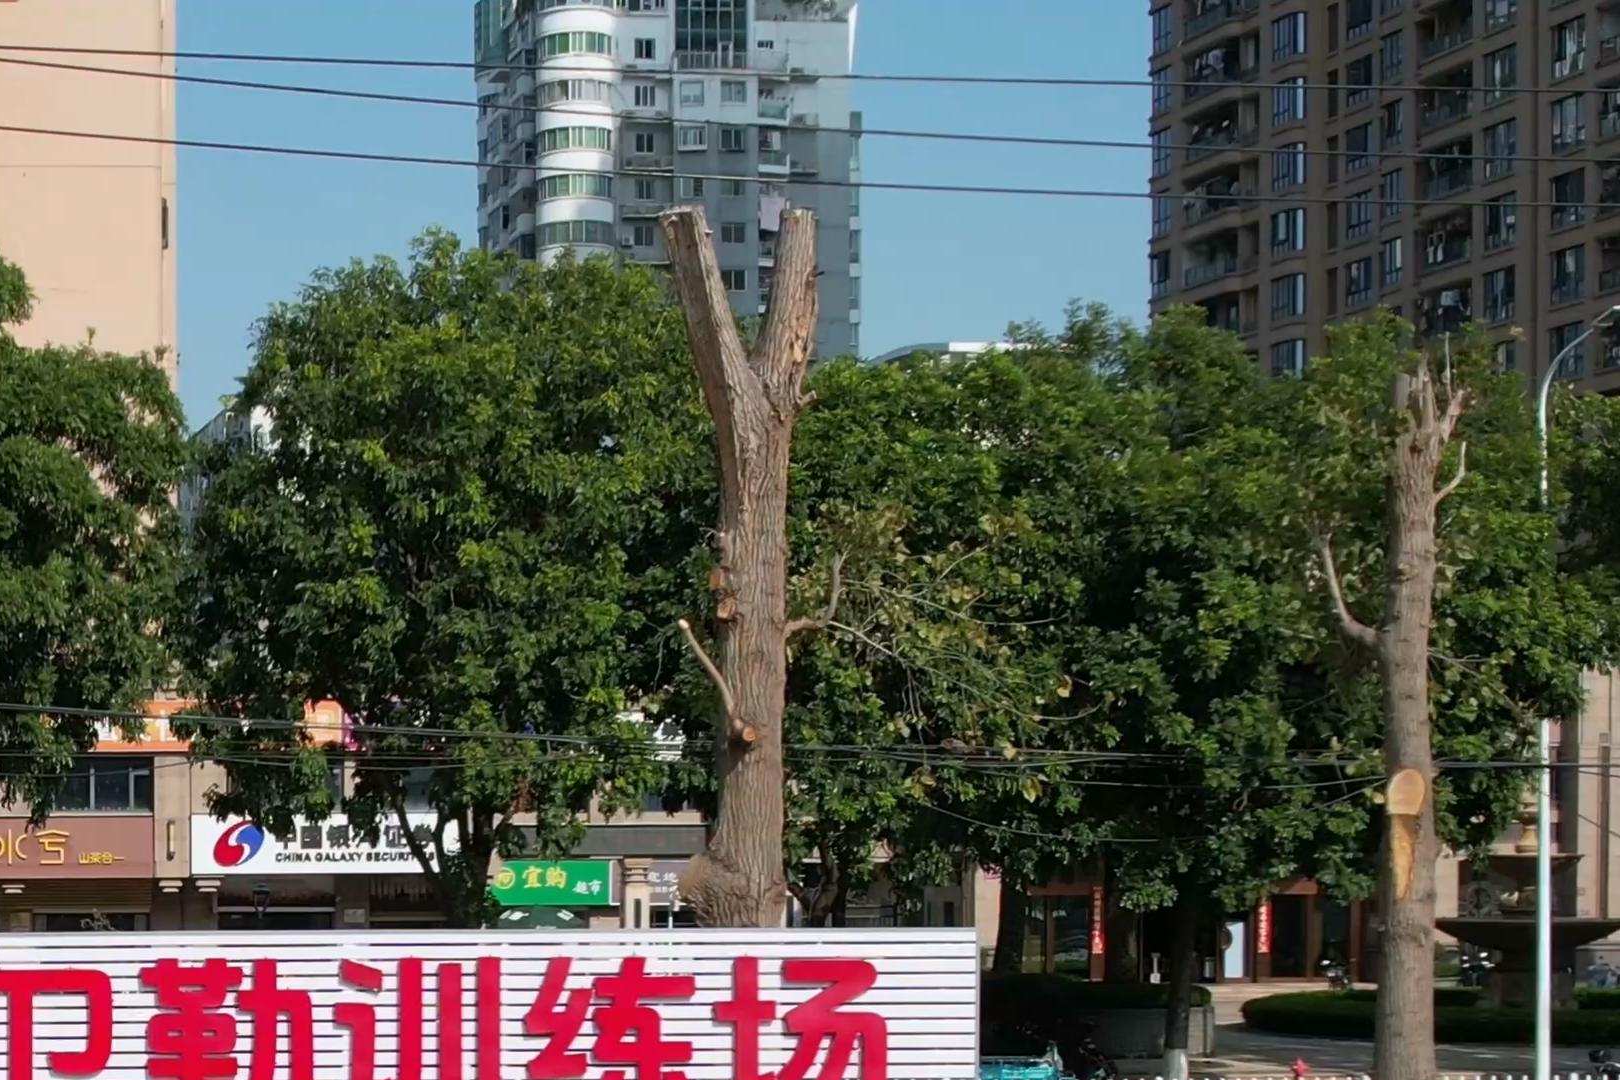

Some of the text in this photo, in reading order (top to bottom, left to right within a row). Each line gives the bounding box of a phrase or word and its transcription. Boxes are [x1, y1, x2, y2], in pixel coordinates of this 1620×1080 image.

[275, 852, 435, 862] CHINA GALAXY SECURITS
